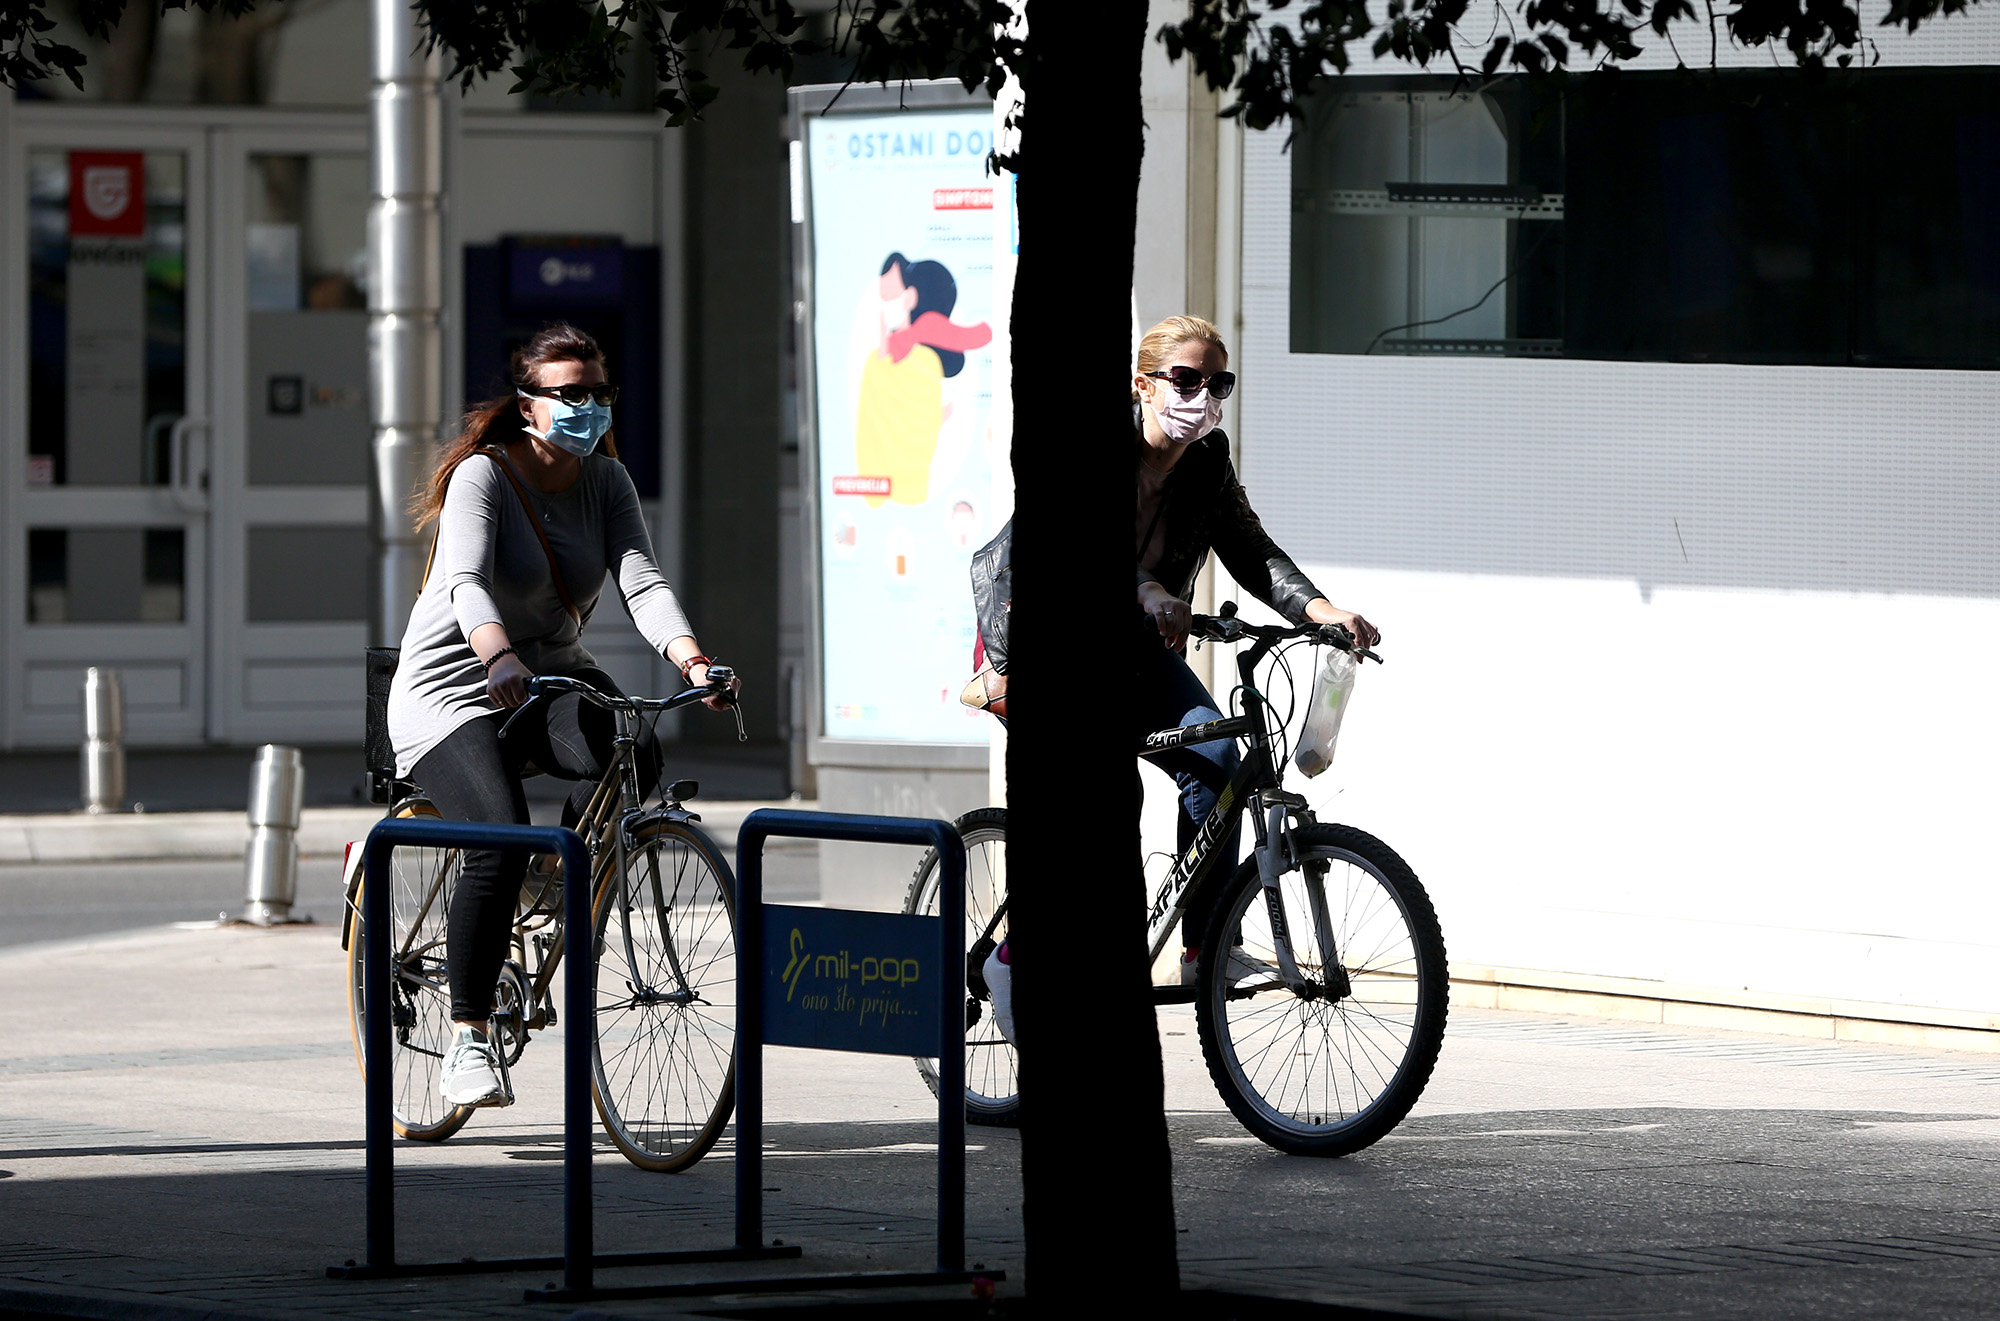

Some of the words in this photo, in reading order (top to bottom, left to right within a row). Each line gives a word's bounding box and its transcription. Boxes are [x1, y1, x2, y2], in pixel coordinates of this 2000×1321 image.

[848, 132, 933, 158] OSTANI
[1148, 805, 1226, 929] APACHE
[1267, 890, 1286, 935] ZOOM
[815, 950, 920, 988] mil-pop
[802, 993, 828, 1010] ono
[834, 984, 856, 1012] što
